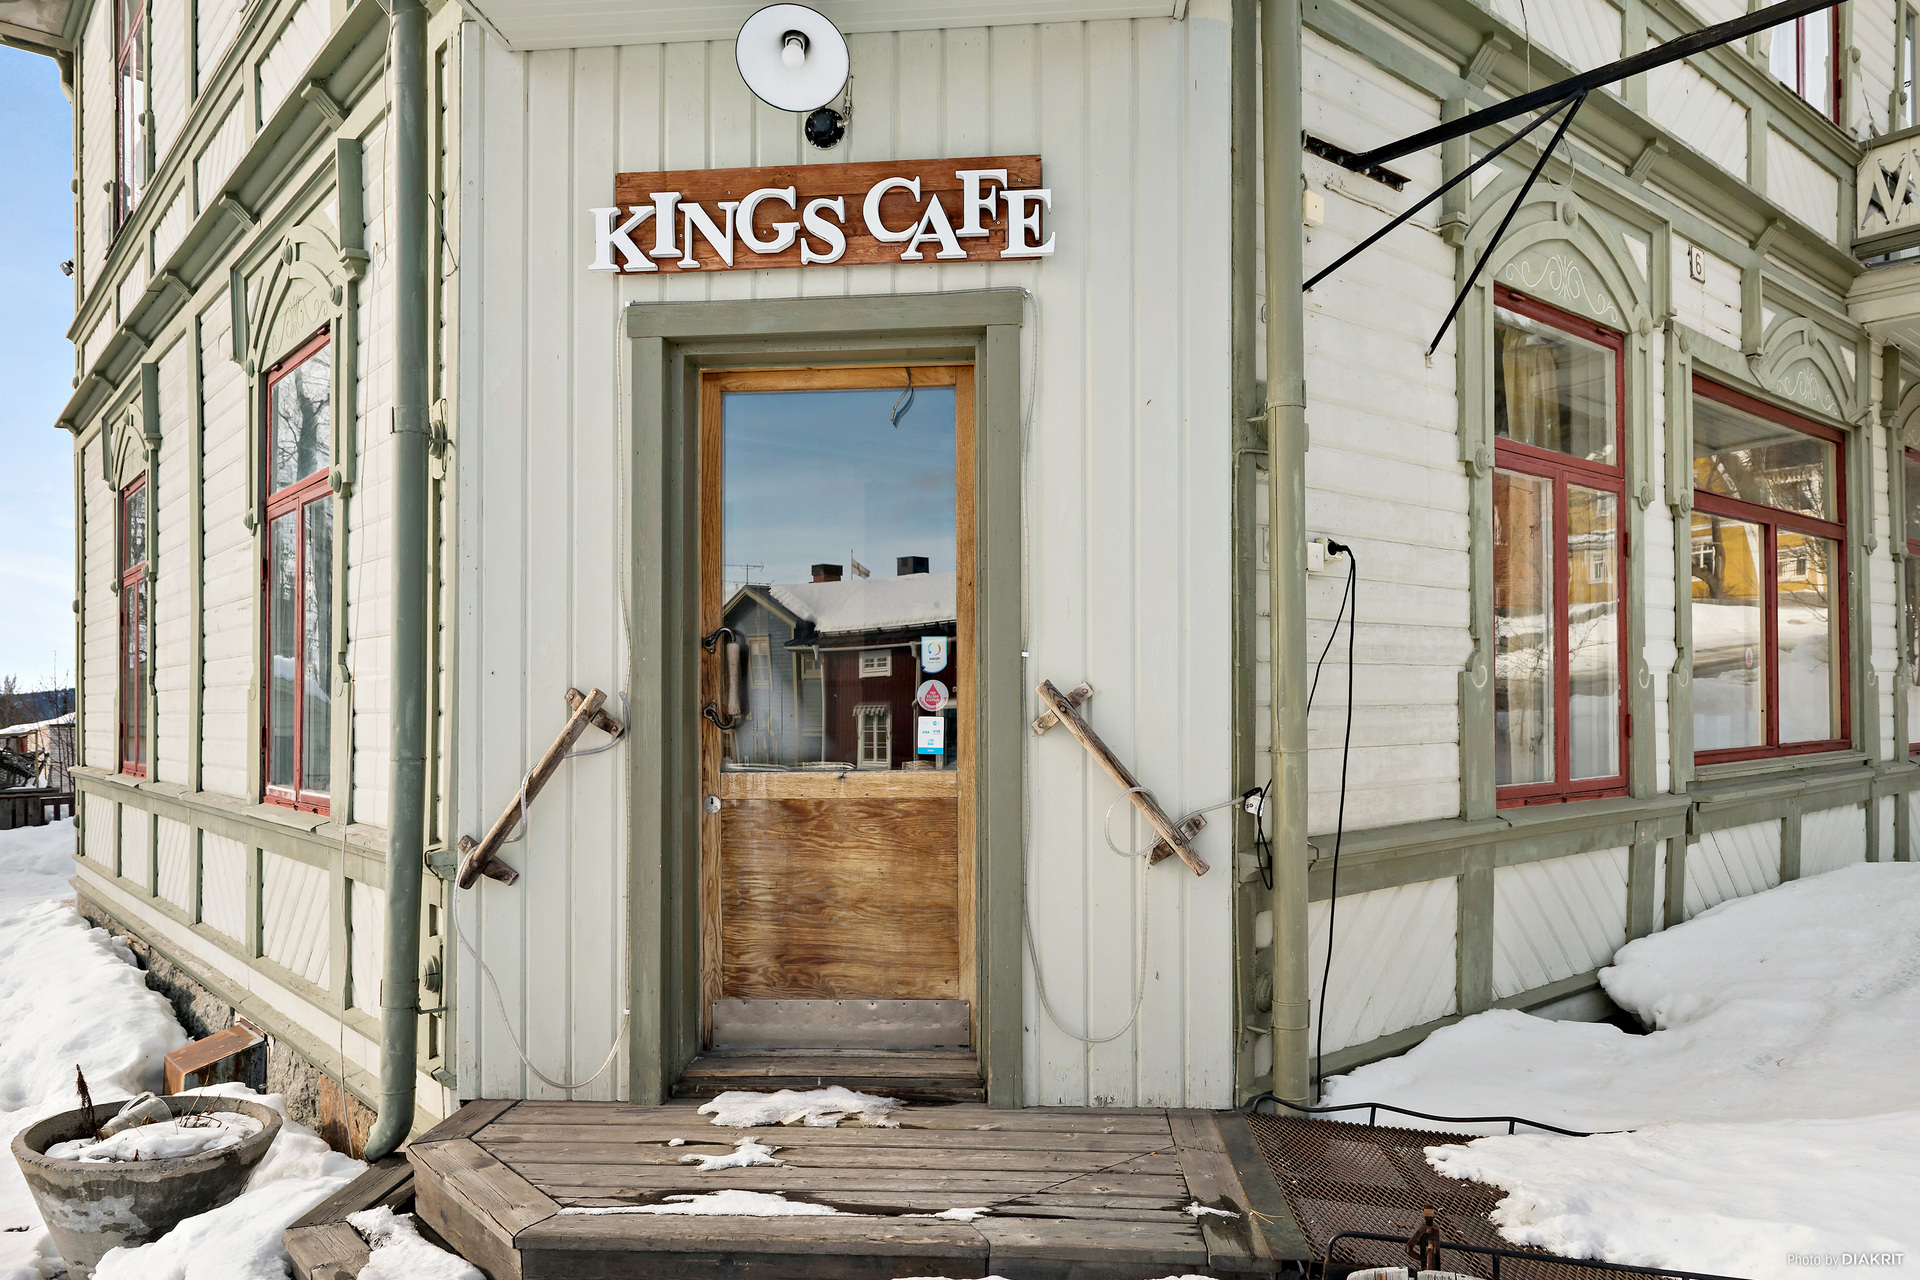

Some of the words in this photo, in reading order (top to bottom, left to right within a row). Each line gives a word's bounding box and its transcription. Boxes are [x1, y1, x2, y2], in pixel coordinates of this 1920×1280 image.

[588, 186, 846, 273] KINGS
[862, 169, 1056, 260] CAFE
[1695, 252, 1702, 276] 6
